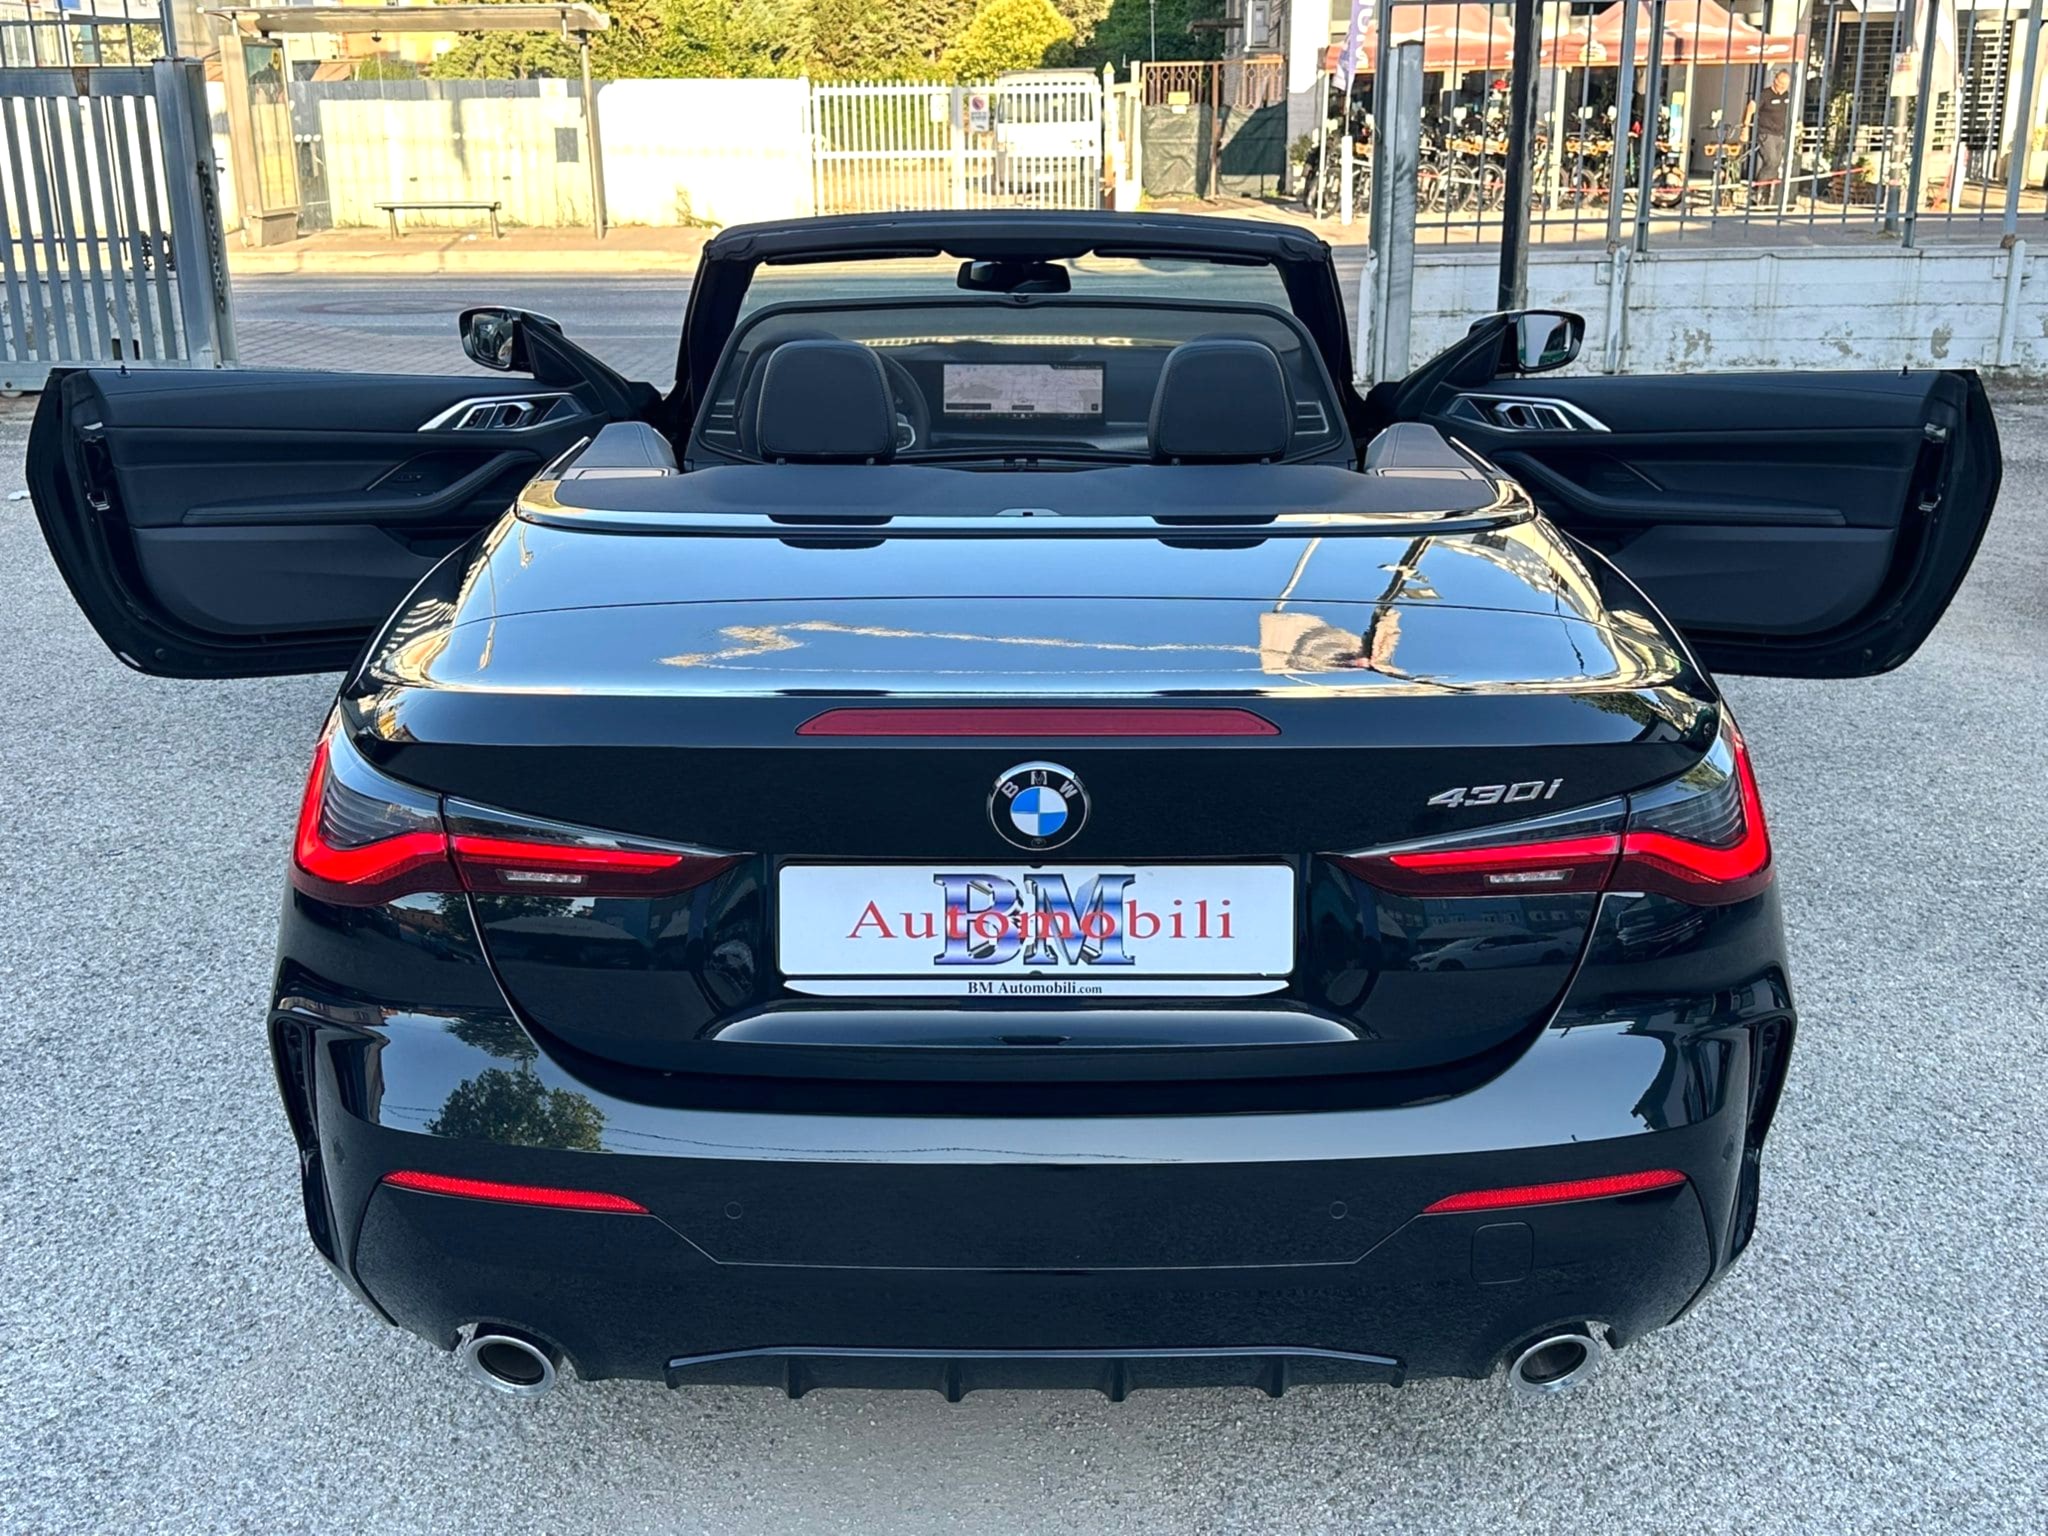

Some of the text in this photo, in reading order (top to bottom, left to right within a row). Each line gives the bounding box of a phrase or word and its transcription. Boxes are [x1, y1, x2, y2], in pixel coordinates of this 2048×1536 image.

[1001, 771, 1078, 799] BMW
[1427, 778, 1564, 808] 430i
[846, 899, 1235, 939] Automobili
[933, 873, 1136, 966] BM
[967, 981, 1103, 994] BM Automobili.com
